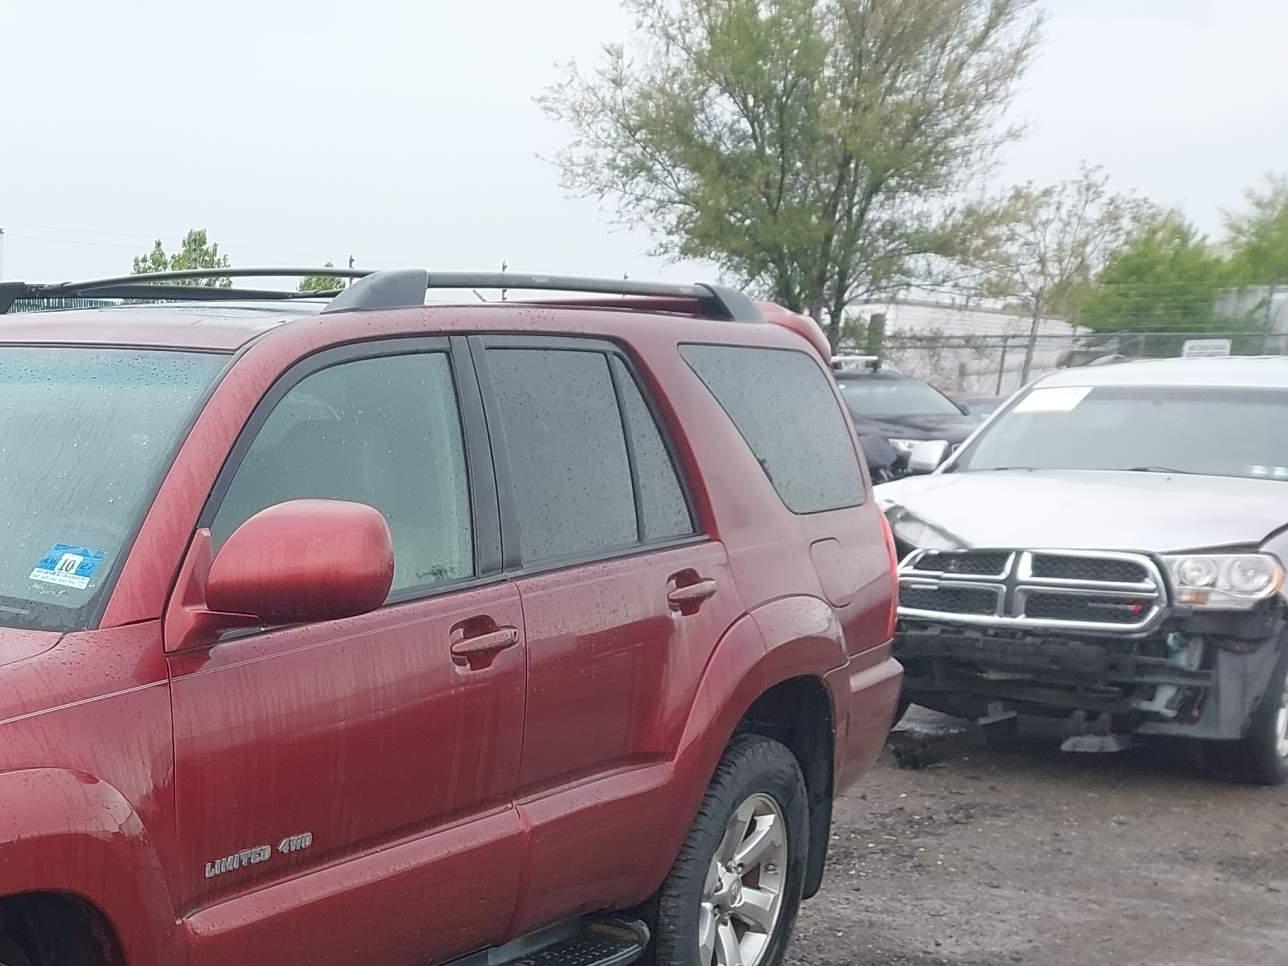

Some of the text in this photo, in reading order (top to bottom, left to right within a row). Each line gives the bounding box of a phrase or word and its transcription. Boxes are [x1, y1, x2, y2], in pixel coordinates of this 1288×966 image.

[57, 557, 77, 573] 10
[205, 832, 313, 878] LIMITED 4WD
